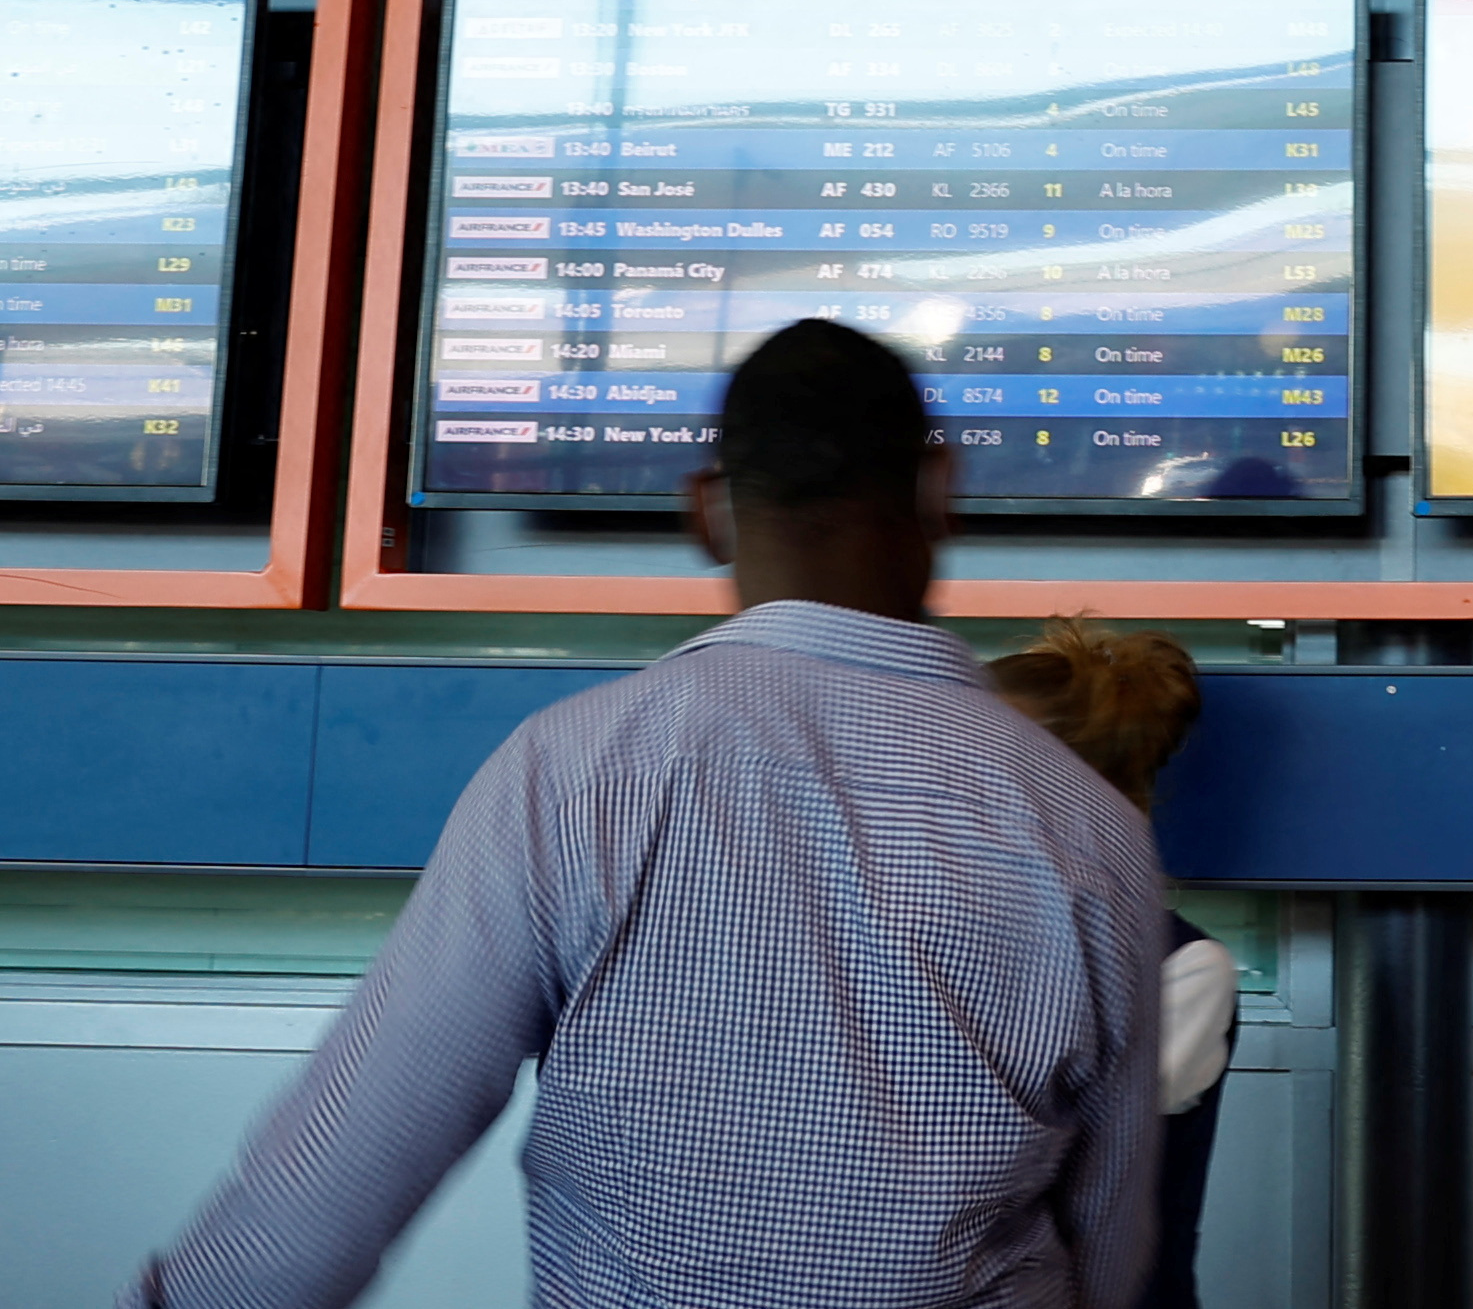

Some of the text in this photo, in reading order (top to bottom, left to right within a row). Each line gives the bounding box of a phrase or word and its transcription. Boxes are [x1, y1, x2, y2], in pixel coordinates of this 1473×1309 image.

[559, 180, 898, 199] 13:40 San José AF 430
[615, 221, 785, 243] Washington Dulles
